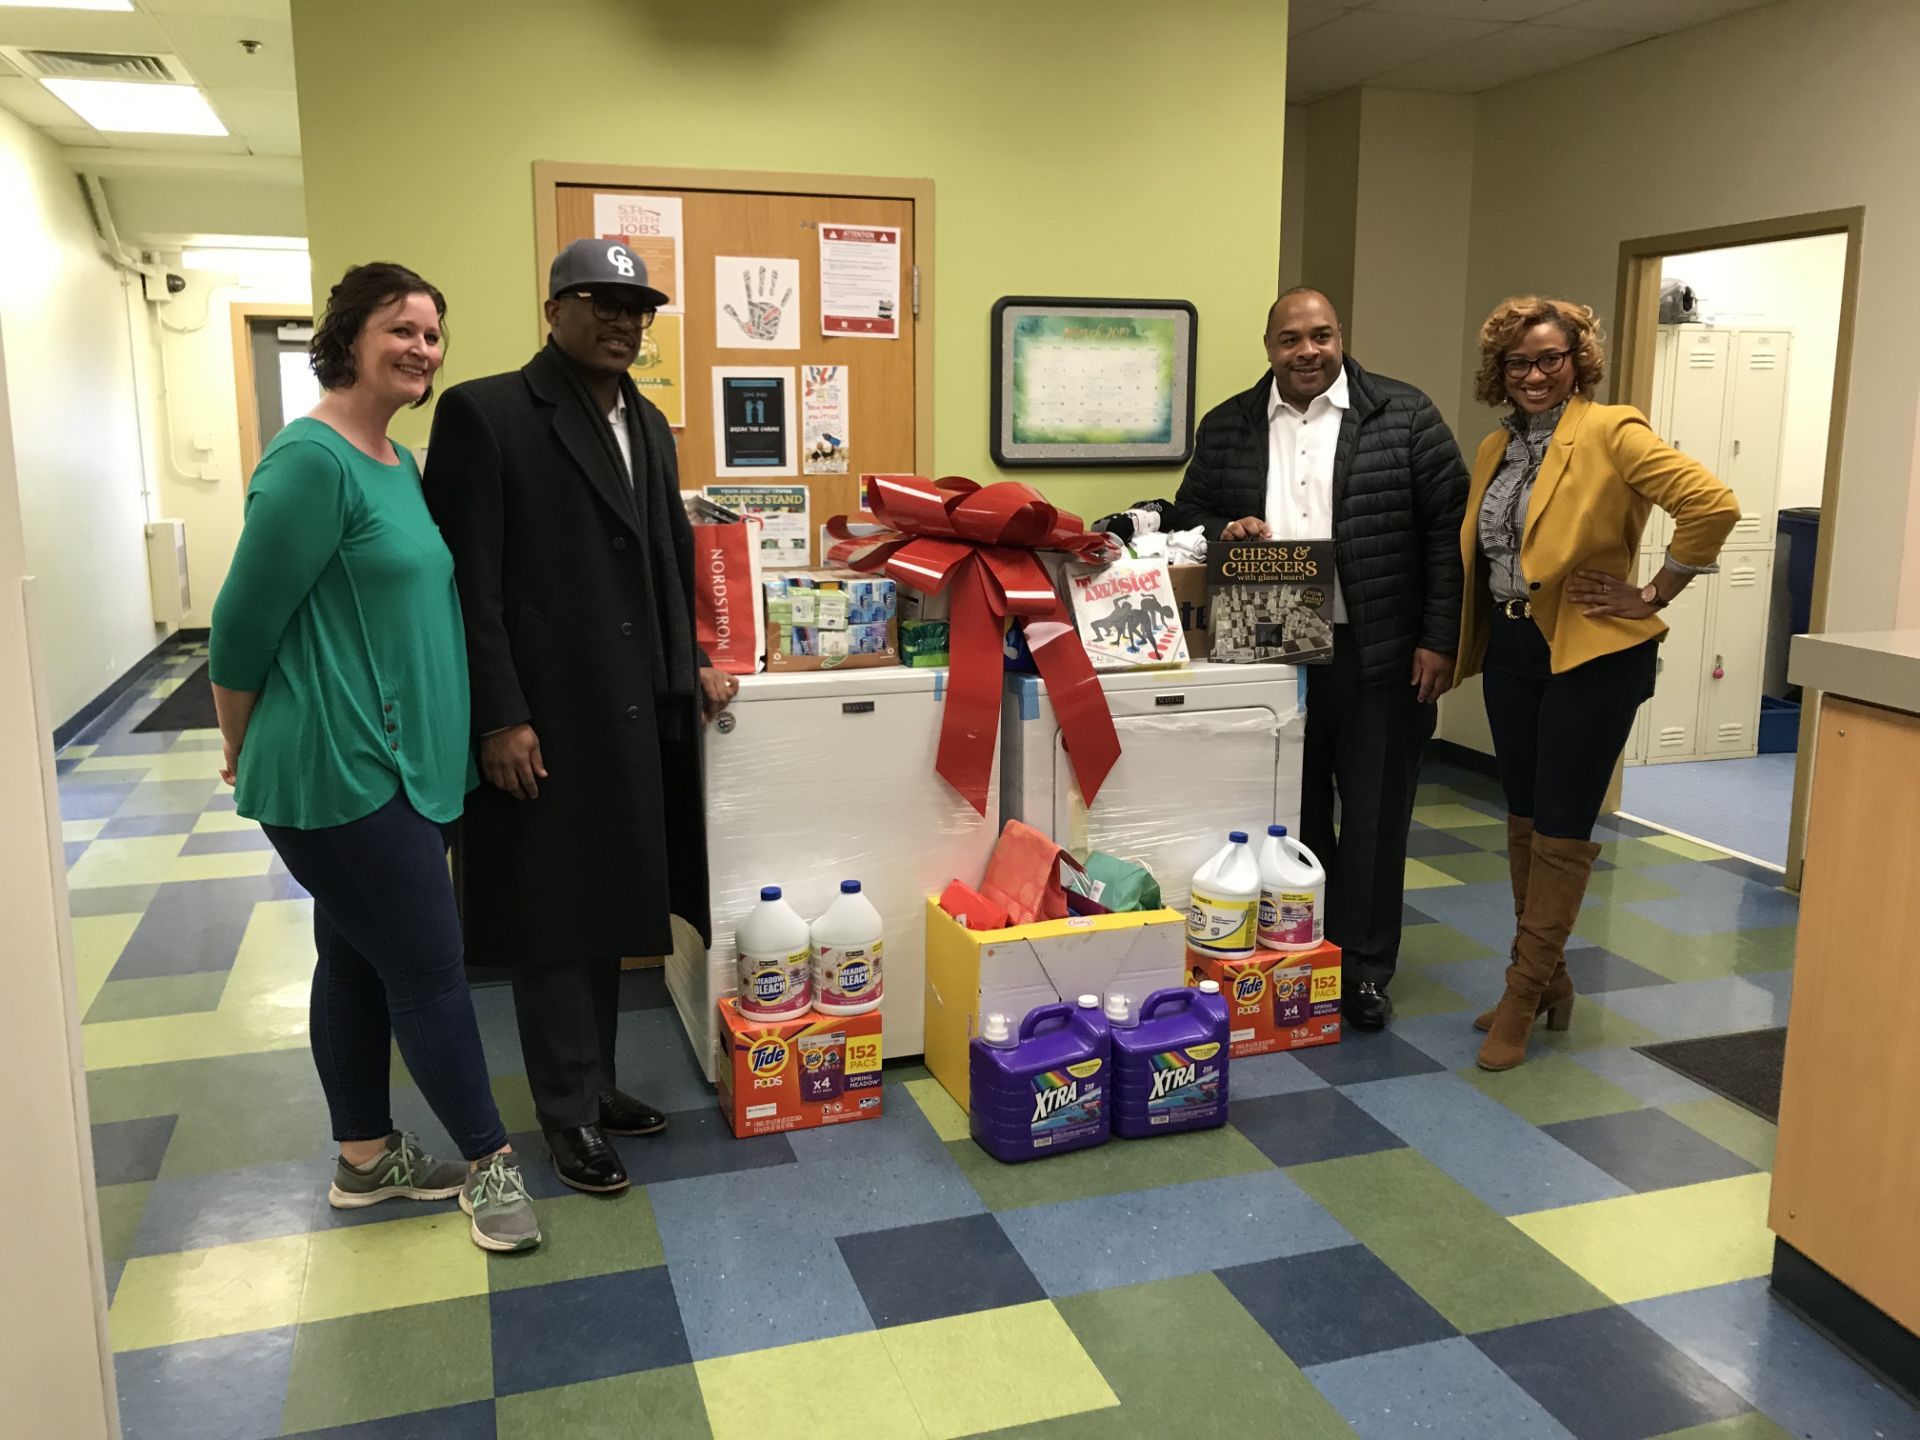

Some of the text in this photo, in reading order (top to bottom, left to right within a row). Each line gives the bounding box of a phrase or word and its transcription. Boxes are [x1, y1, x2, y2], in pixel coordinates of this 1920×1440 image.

[619, 215, 660, 223] YOUTH
[620, 224, 661, 235] JOBS
[842, 230, 875, 238] ATTENTION
[765, 495, 803, 505] STAND
[1229, 546, 1311, 561] CHESS &
[1222, 561, 1318, 577] CHECKERS
[1237, 573, 1305, 582] with glass board
[1074, 569, 1162, 602] Twister
[710, 548, 731, 650] NORDSTROM
[840, 965, 869, 976] MEADOW
[754, 974, 785, 985] MEADOW
[839, 972, 870, 987] BLEACH
[1313, 975, 1337, 990] 152
[753, 982, 786, 995] BLEACH
[1236, 976, 1264, 1000] Tide
[1314, 989, 1337, 998] PACS
[1237, 1005, 1261, 1016] PODS
[1284, 1004, 1299, 1017] x4
[752, 1044, 785, 1072] Tide
[848, 1044, 877, 1060] 152
[850, 1058, 877, 1069] PACS
[754, 1076, 783, 1090] PODS
[813, 1077, 831, 1090] x4
[850, 1075, 873, 1083] SPRING
[1148, 1063, 1195, 1100] XTRA
[1031, 1081, 1077, 1122] XTRA
